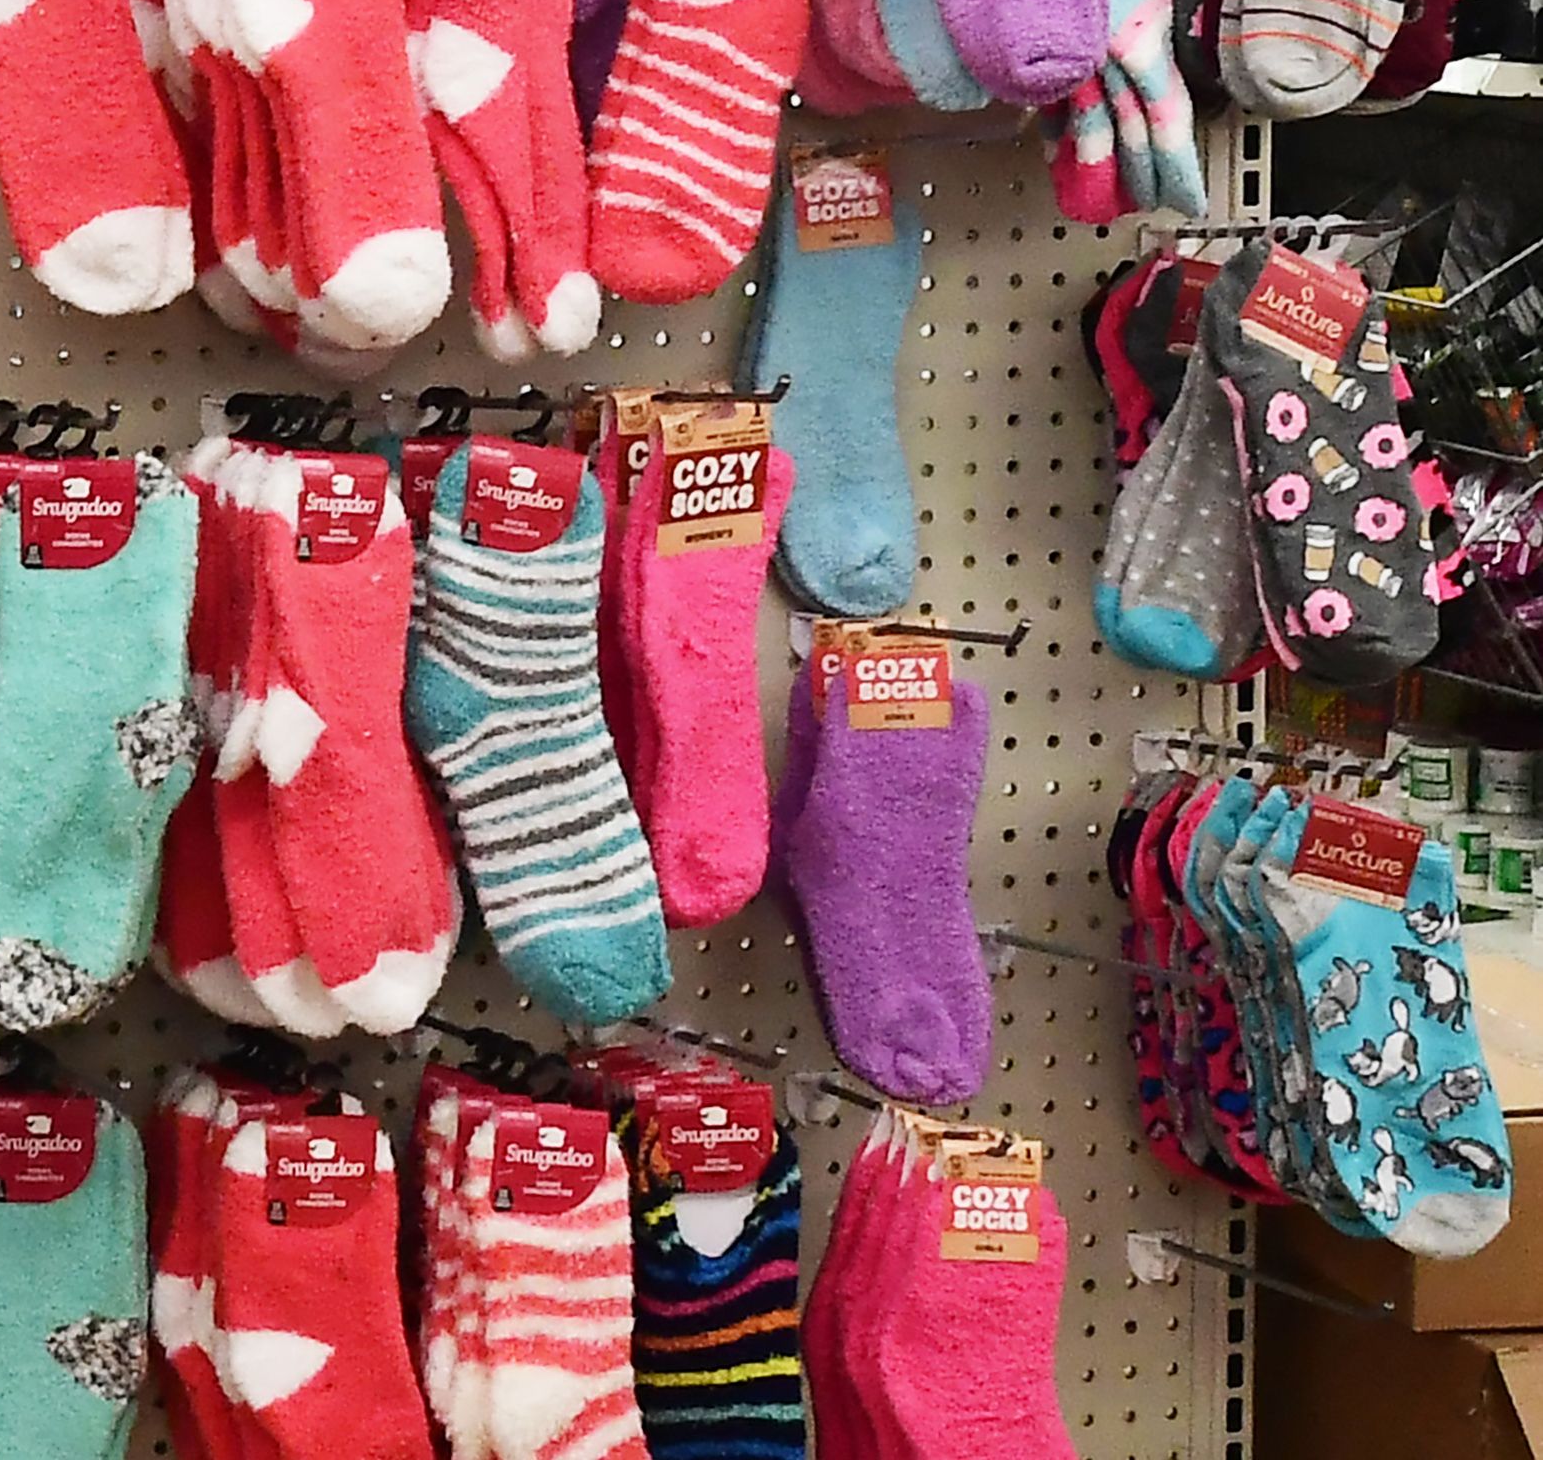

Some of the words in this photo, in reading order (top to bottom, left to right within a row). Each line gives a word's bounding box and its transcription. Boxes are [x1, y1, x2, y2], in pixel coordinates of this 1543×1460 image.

[804, 176, 884, 203] COZY
[807, 200, 880, 223] SOCKS
[1256, 285, 1343, 339] Juncture
[672, 451, 761, 491] COZY
[305, 491, 377, 519] Snugadoo
[476, 479, 565, 512] Snugadoo
[670, 484, 755, 518] SOCKS
[32, 496, 122, 523] Snugadoo
[855, 657, 939, 681] COZY
[858, 681, 939, 701] SOCKS
[1306, 838, 1404, 877] Juncture
[670, 1124, 760, 1151] Snugadoo
[276, 1158, 366, 1183] Snugadoo
[505, 1144, 595, 1175] Snugadoo
[952, 1185, 1030, 1210] COZY
[953, 1210, 1029, 1231] SOCKS
